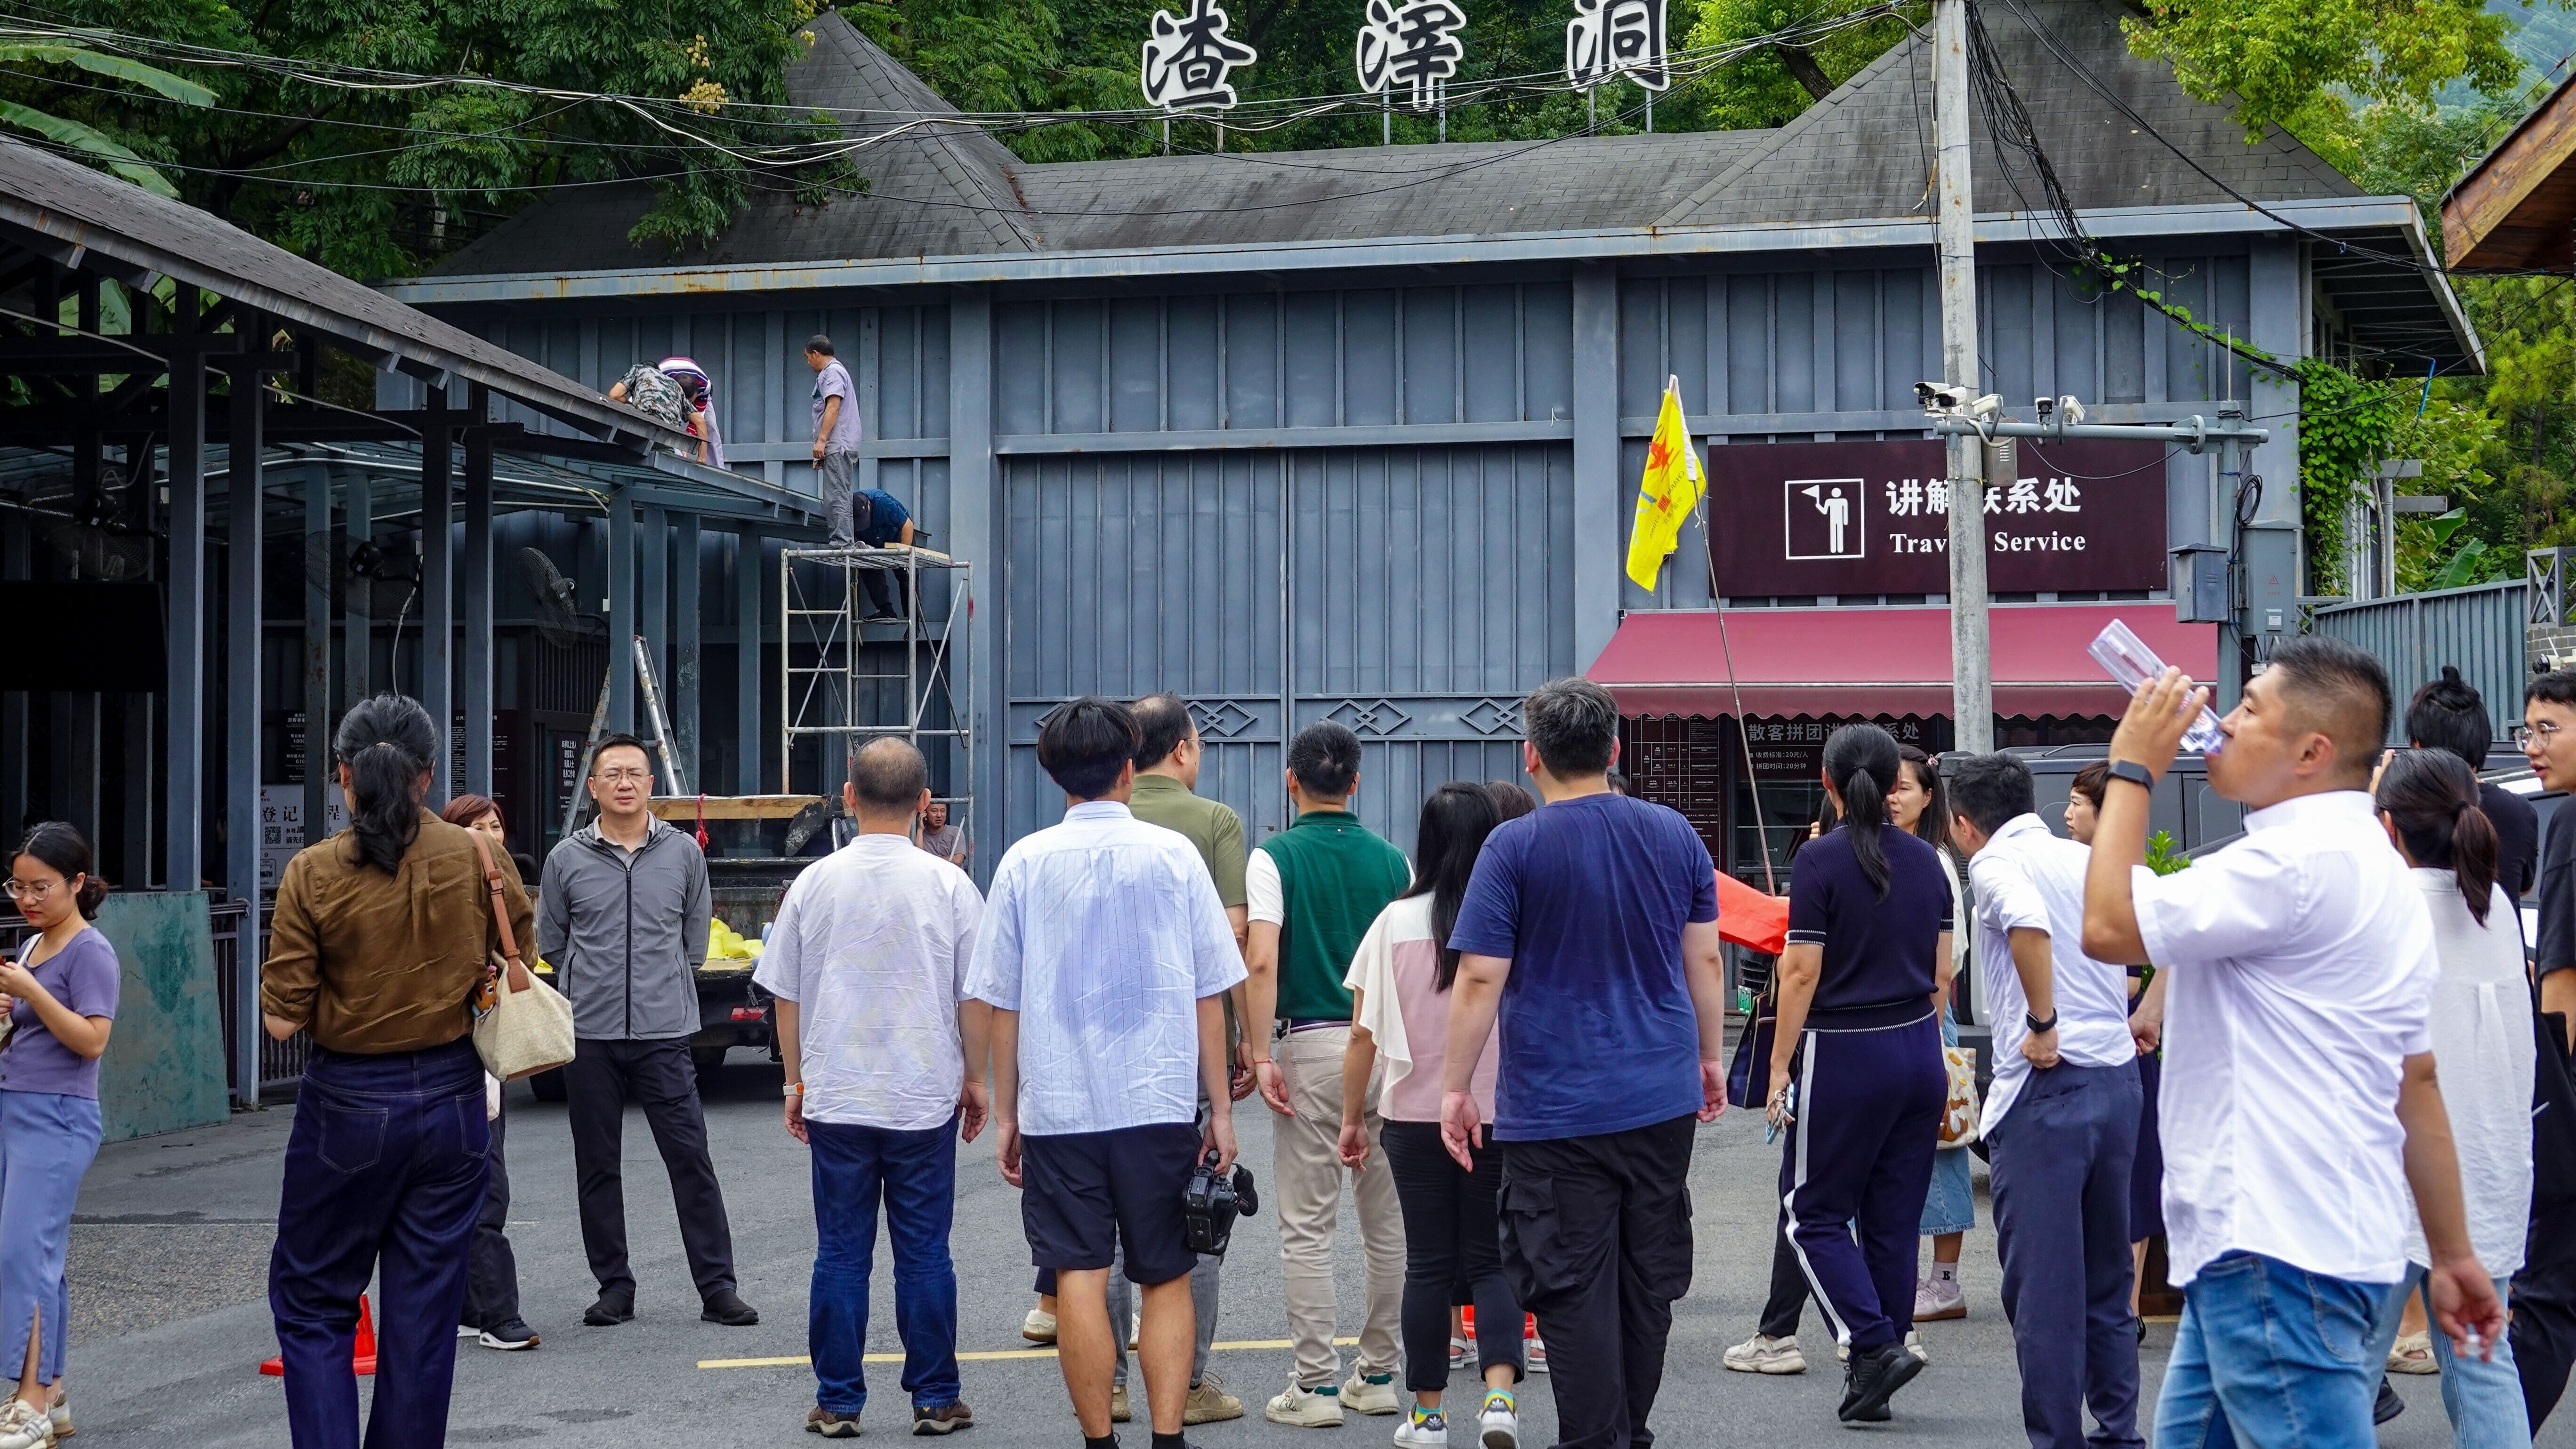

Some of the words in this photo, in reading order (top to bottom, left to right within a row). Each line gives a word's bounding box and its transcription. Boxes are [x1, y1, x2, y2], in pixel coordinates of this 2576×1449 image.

[1890, 533, 1947, 553] Trav
[1994, 531, 2086, 552] Service
[1748, 723, 1920, 741] 散客拼团讲系处
